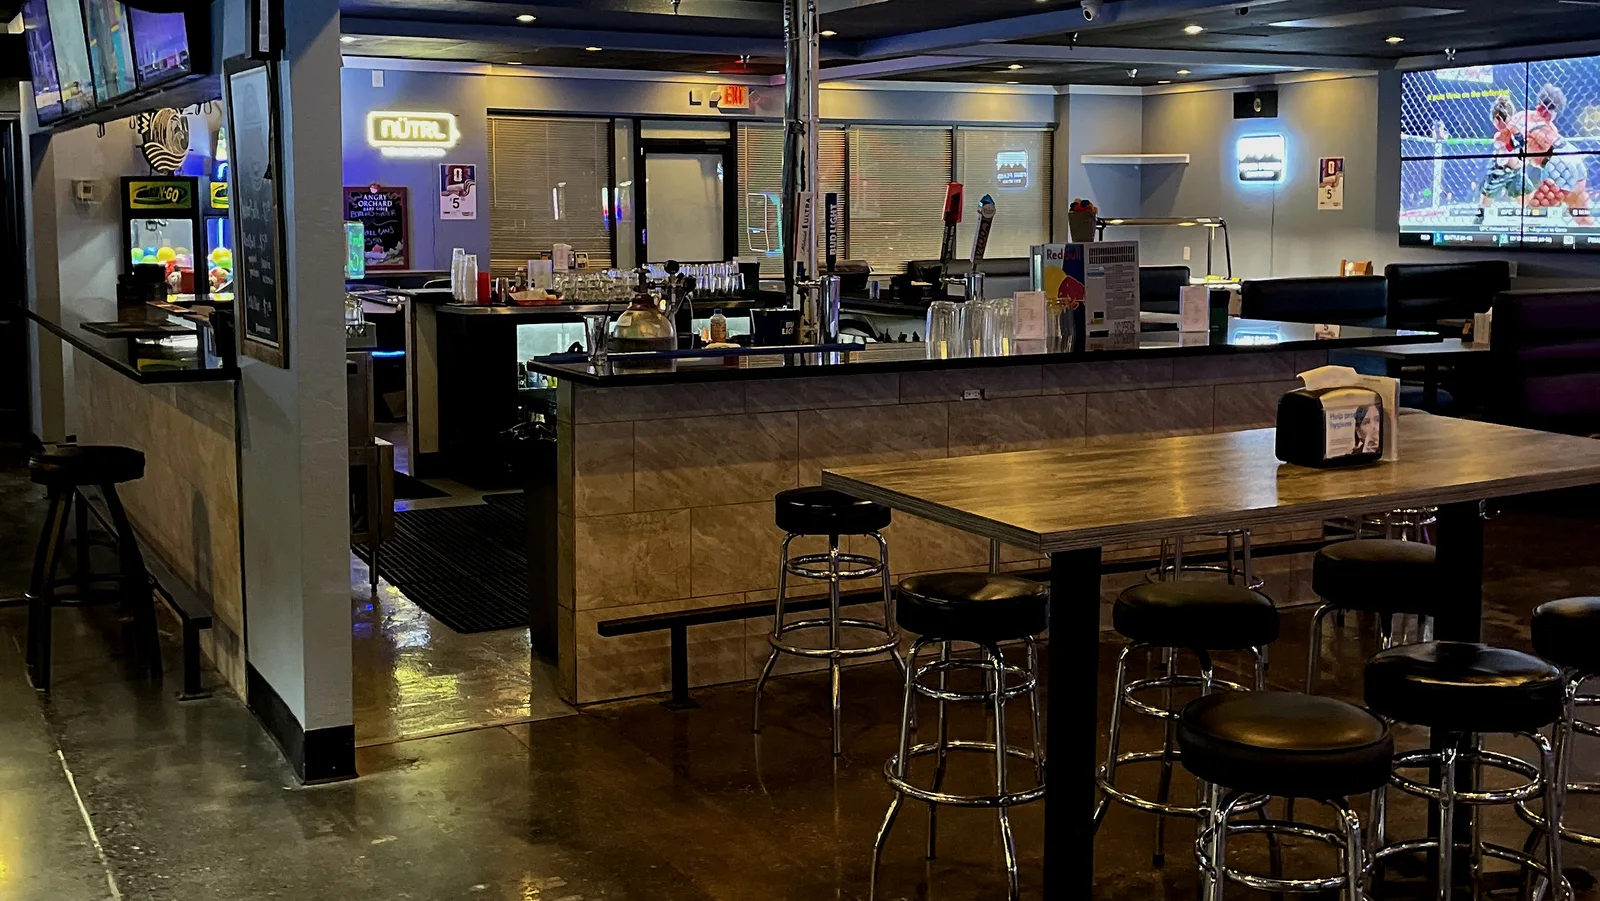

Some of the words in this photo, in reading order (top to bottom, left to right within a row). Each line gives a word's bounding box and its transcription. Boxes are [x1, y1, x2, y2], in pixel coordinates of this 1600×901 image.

[724, 86, 745, 105] EXIT
[803, 198, 811, 224] ULTRA
[829, 203, 838, 234] LIGHT
[829, 234, 837, 256] BUD
[1047, 249, 1063, 260] Red
[1064, 248, 1080, 260] Bull
